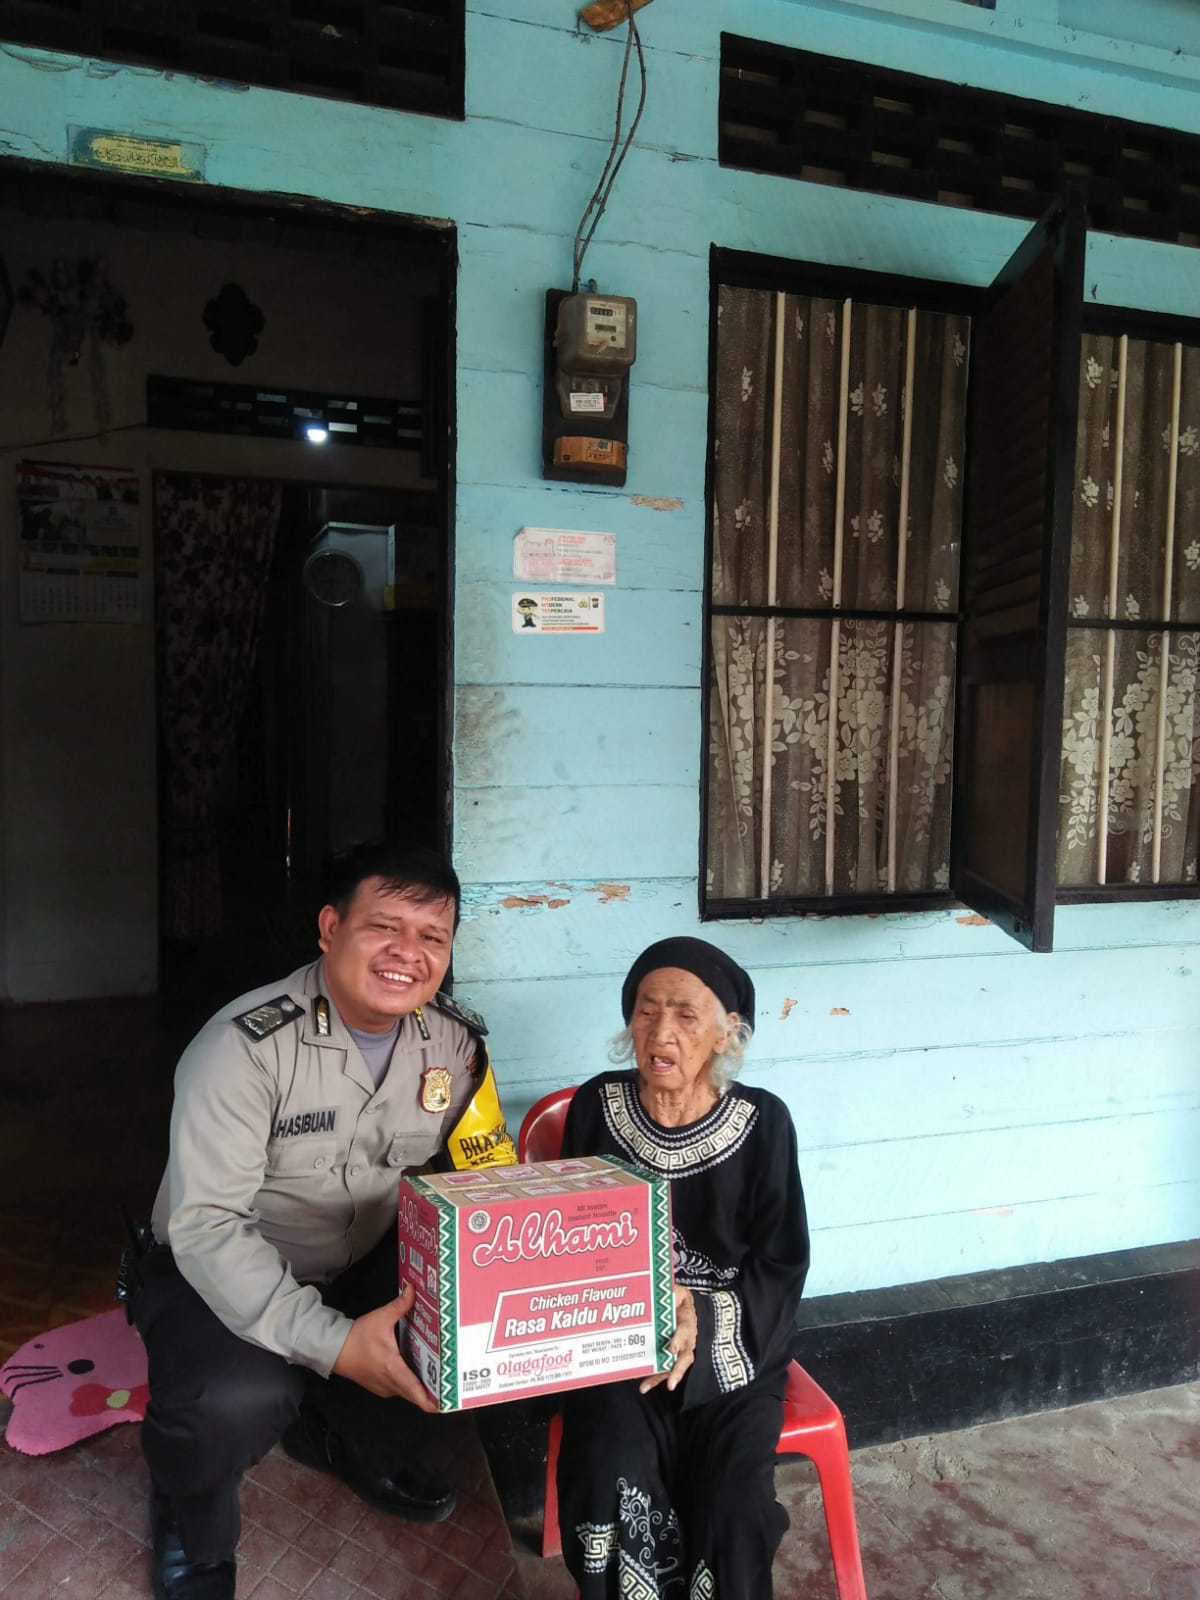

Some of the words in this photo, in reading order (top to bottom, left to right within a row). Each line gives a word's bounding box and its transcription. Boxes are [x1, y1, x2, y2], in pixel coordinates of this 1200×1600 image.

[275, 1111, 336, 1138] HASIBUAN
[592, 1210, 616, 1220] Noodle
[473, 1209, 638, 1267] Alhami
[529, 1293, 579, 1311] Chicken
[581, 1286, 628, 1304] Flavour
[504, 1317, 546, 1338] Rasa
[550, 1306, 598, 1330] Kaldu
[601, 1301, 646, 1324] Ayam
[628, 1333, 646, 1346] 60g
[463, 1367, 491, 1381] ISO
[496, 1349, 573, 1377] Olagafood
